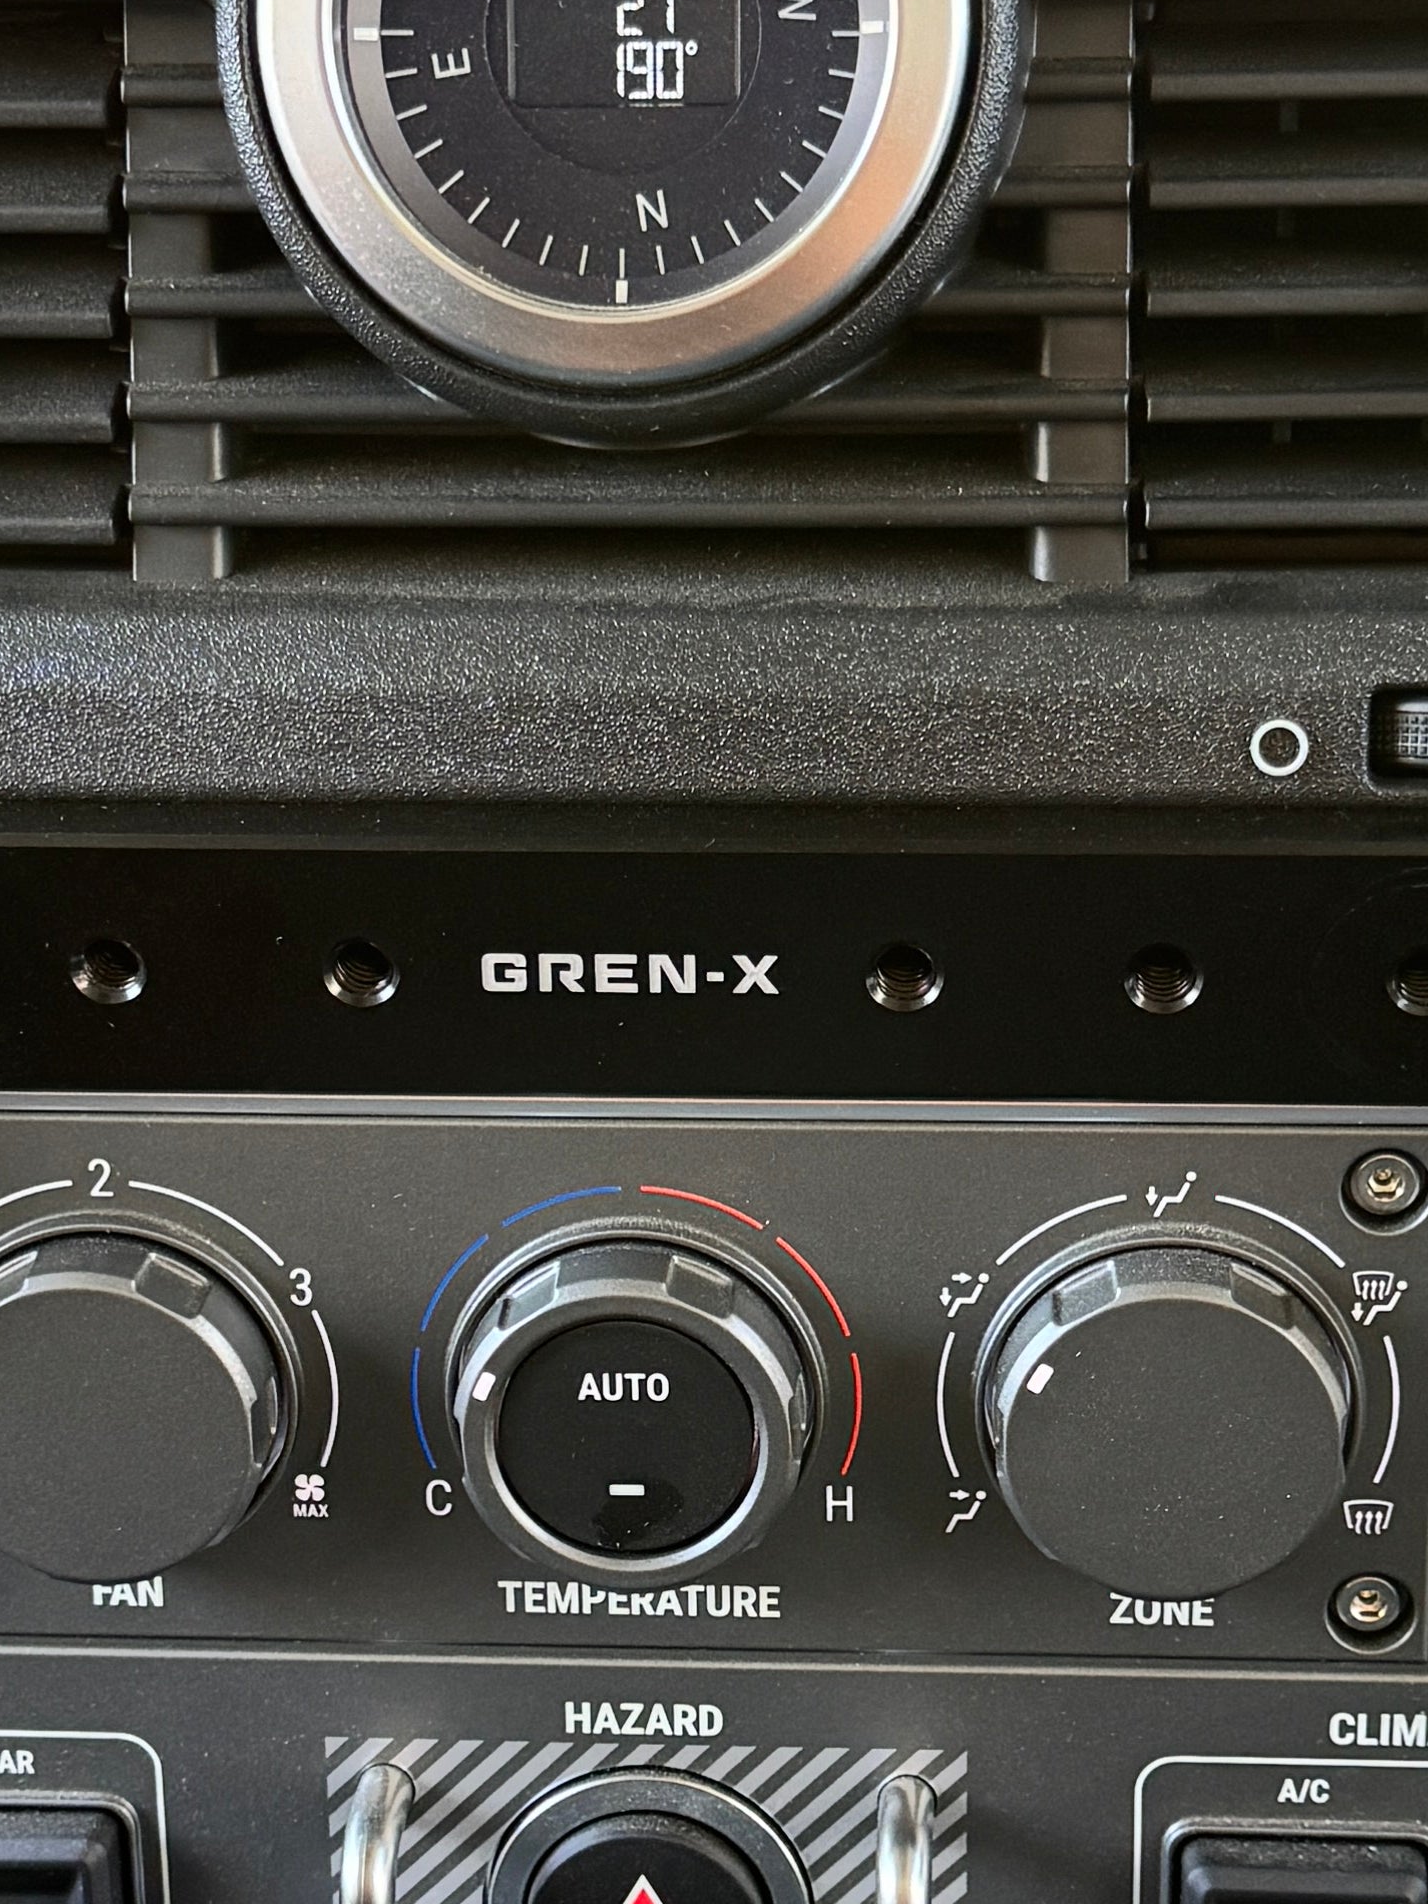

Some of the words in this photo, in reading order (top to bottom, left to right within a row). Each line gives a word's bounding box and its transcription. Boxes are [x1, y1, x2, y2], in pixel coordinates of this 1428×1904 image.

[431, 48, 470, 79] E
[636, 190, 668, 231] N
[482, 953, 779, 994] GREN-X
[88, 1159, 113, 1196] 2
[290, 1268, 312, 1306] 3
[578, 1373, 669, 1401] AUTO
[293, 1504, 328, 1517] MAX
[426, 1480, 452, 1515] C
[826, 1486, 853, 1521] H
[93, 1576, 163, 1607] FAN
[498, 1581, 780, 1617] TEMPERATURE
[1110, 1593, 1214, 1626] ZONE
[565, 1702, 723, 1736] HAZARD
[1278, 1779, 1329, 1803] A/C
